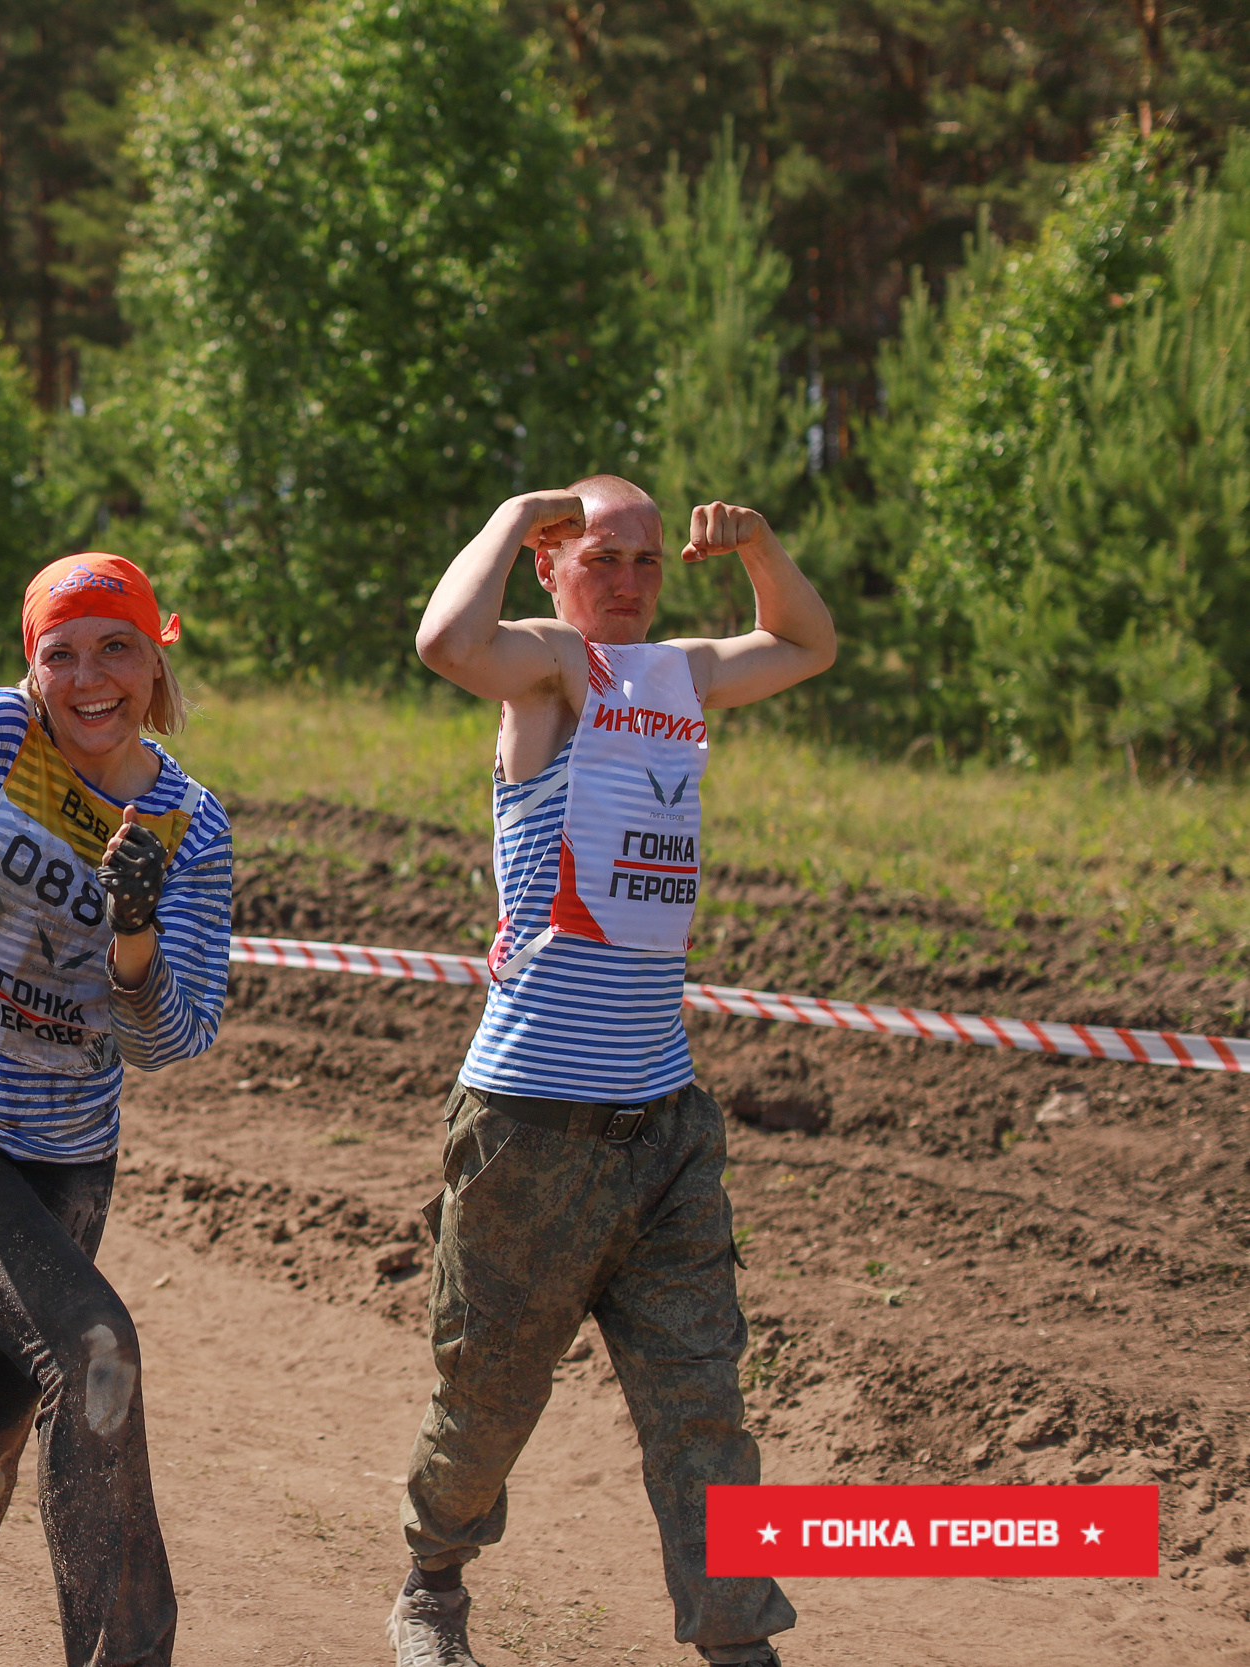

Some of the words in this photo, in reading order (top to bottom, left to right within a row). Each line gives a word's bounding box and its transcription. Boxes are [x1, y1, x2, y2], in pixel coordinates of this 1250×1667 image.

[60, 788, 111, 845] ВЗВ
[649, 811, 665, 820] ЛИГА
[666, 813, 685, 822] ГЕРОЕВ
[623, 830, 695, 862] ГОНКА
[1, 834, 105, 928] 088
[609, 872, 696, 904] ГЕРОЕВ
